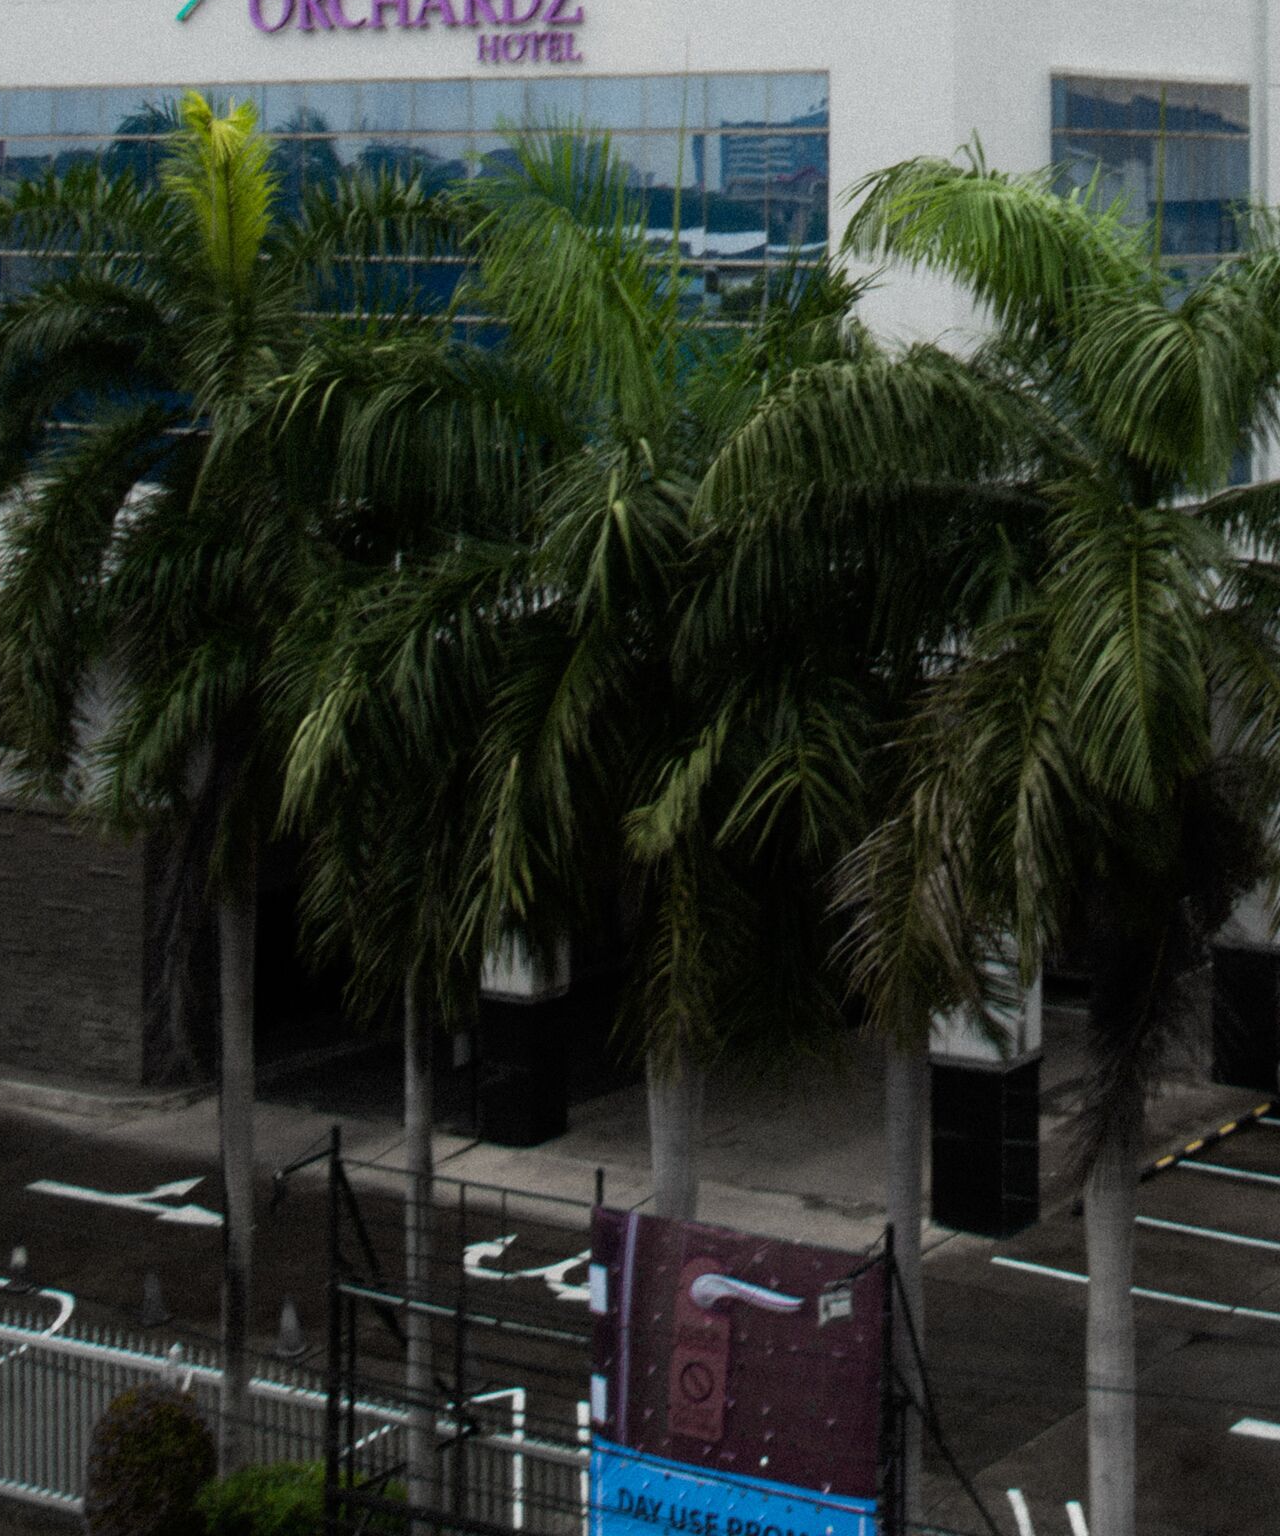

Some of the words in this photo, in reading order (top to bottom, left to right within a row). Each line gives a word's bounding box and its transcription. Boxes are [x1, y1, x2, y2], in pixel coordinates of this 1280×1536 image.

[477, 32, 583, 64] HOTEL
[618, 1487, 664, 1524] DAY
[670, 1503, 719, 1536] USE
[728, 1517, 810, 1536] PR
